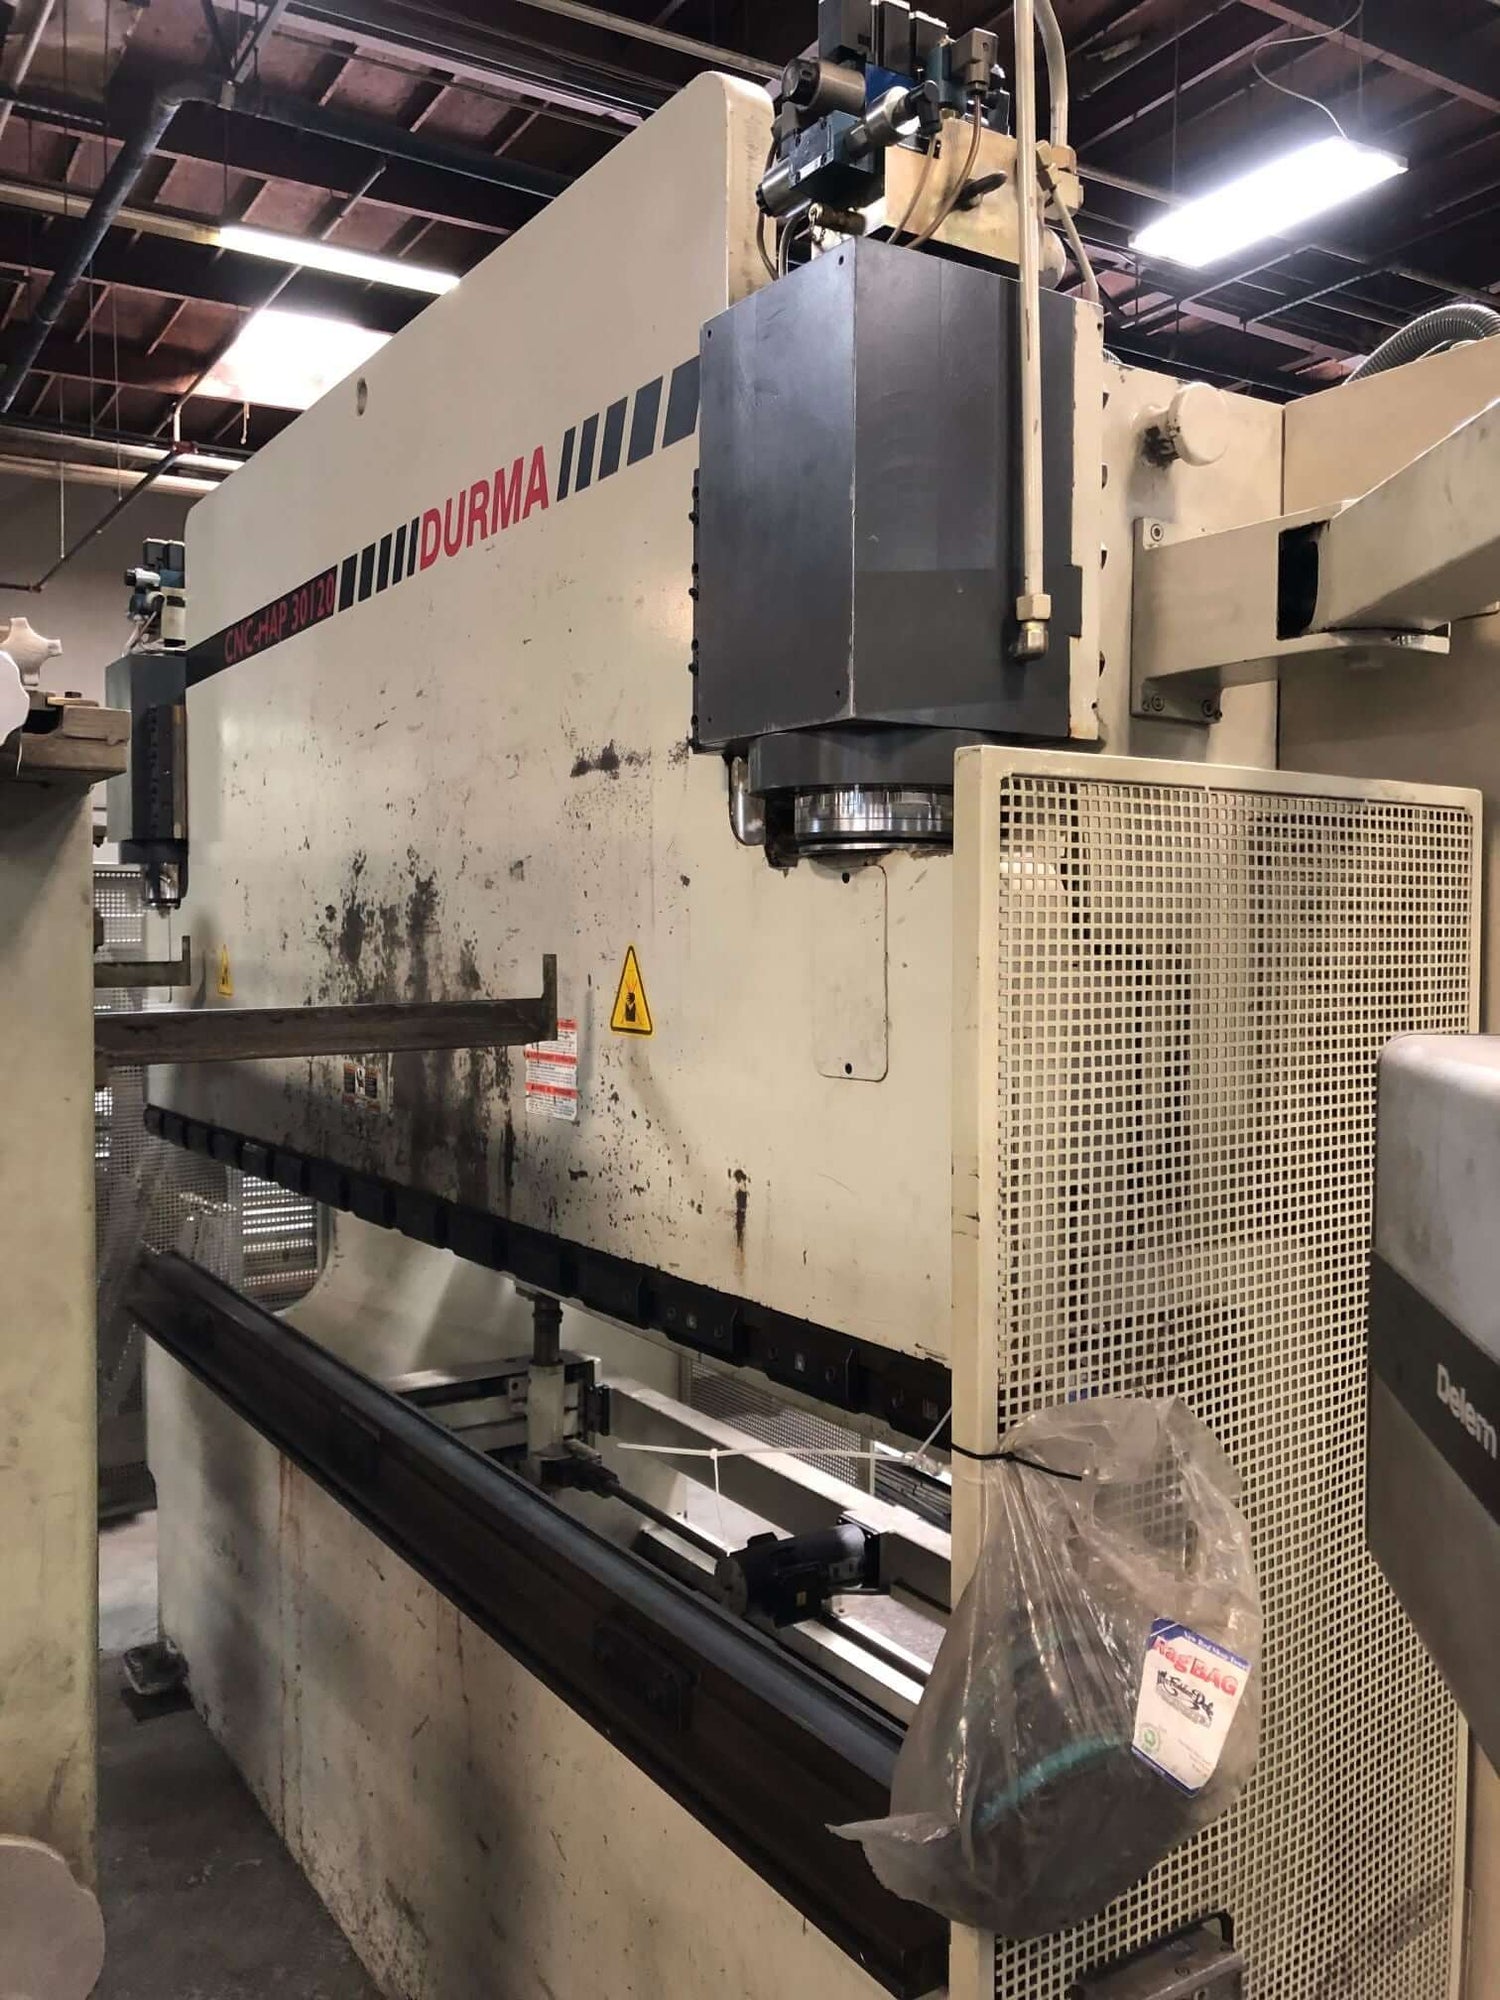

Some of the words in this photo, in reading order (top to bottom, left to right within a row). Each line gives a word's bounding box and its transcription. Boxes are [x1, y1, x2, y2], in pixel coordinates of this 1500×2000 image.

[419, 446, 549, 571] DURMA
[224, 602, 287, 664] CNC-HAP
[1437, 1363, 1497, 1460] Delem
